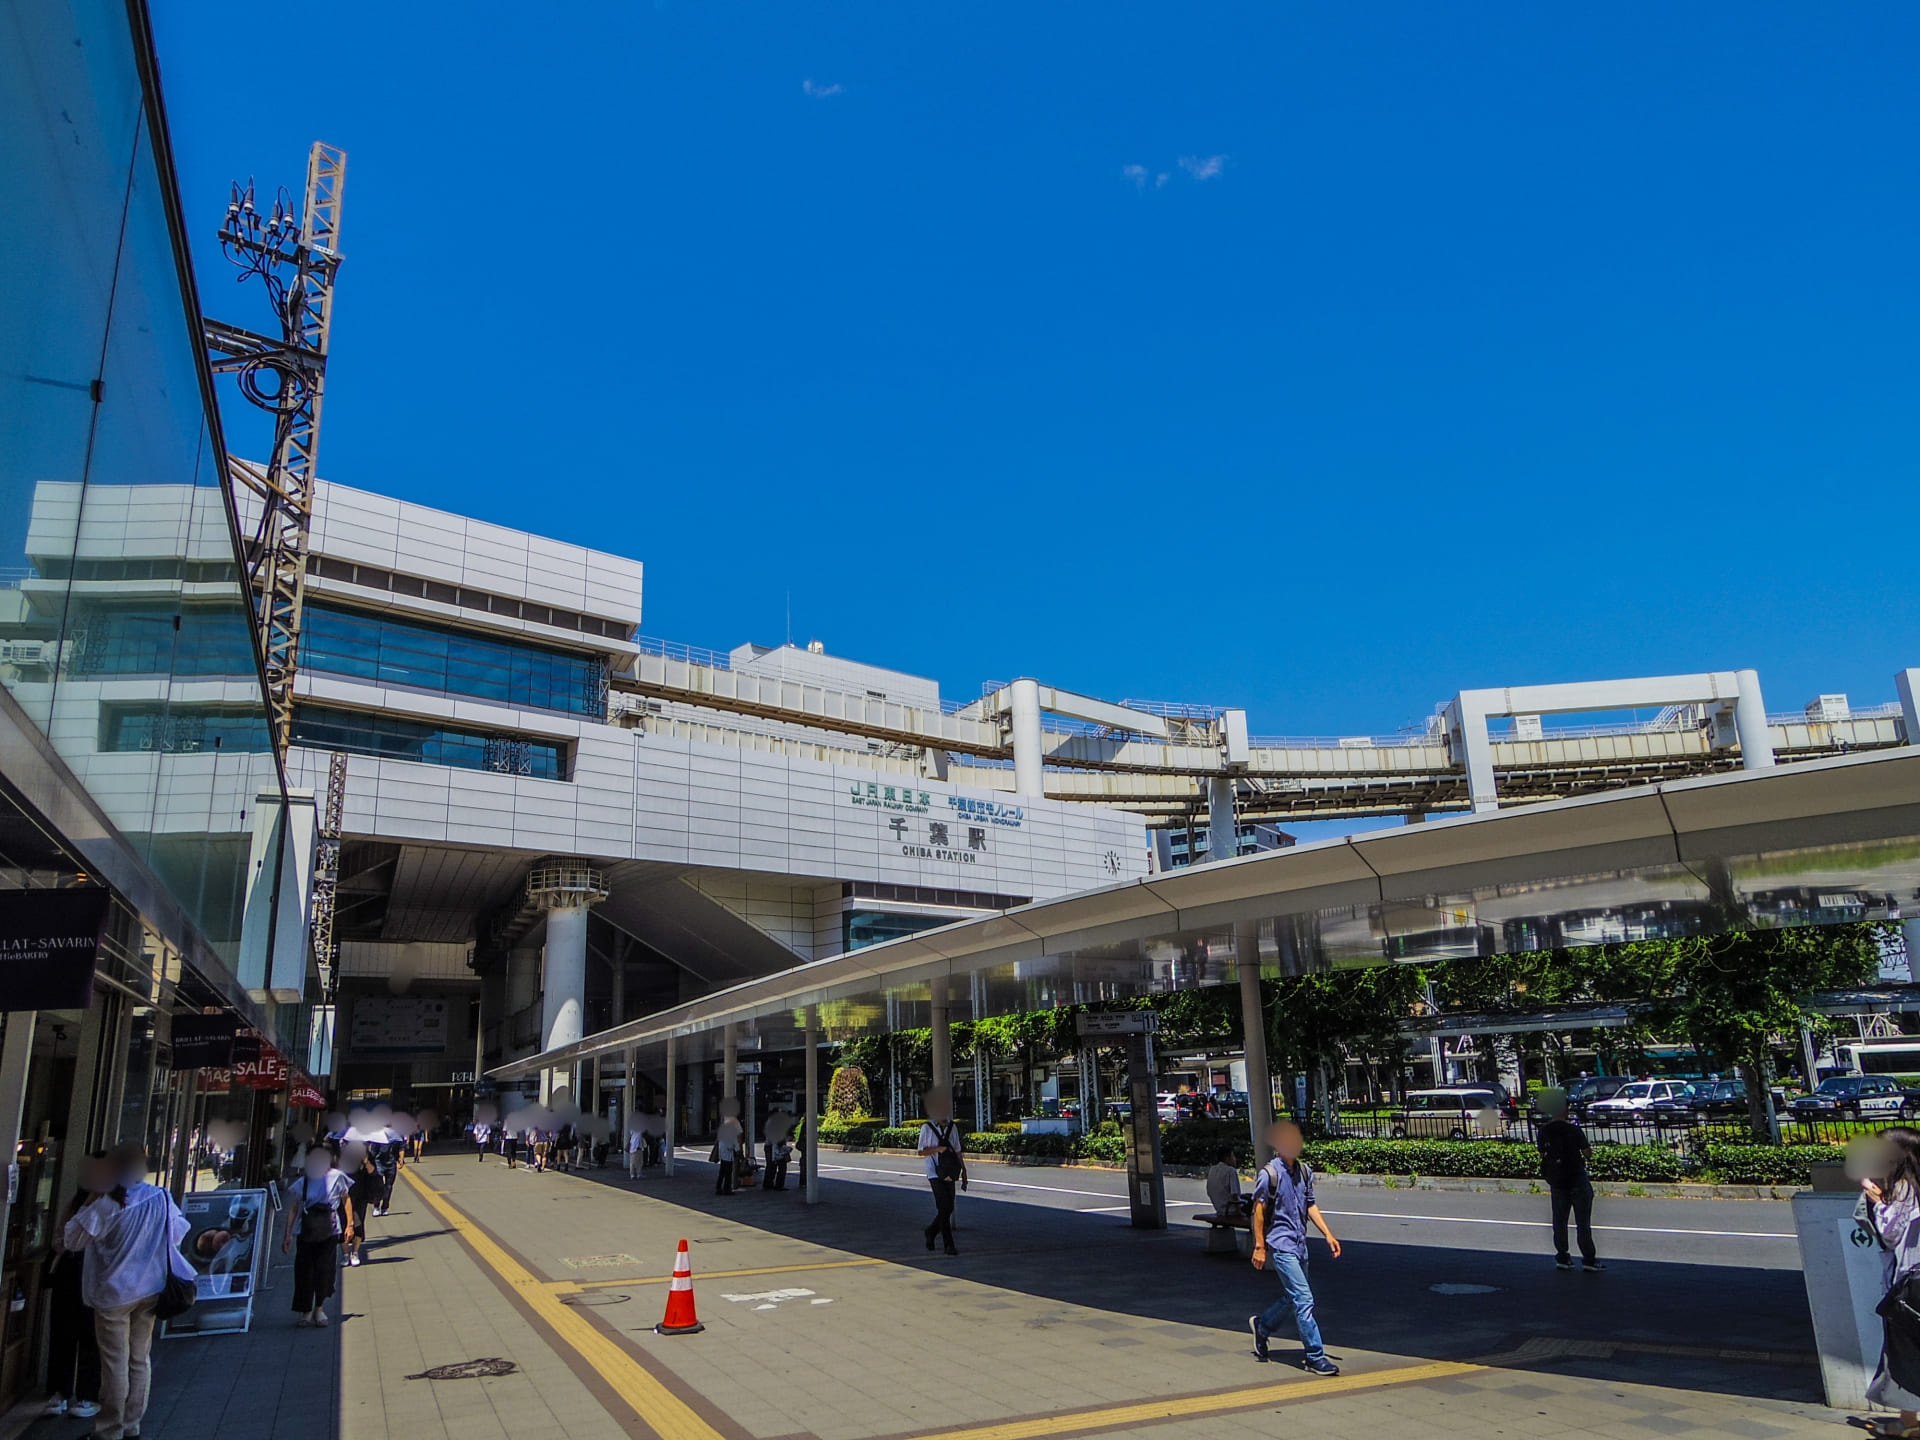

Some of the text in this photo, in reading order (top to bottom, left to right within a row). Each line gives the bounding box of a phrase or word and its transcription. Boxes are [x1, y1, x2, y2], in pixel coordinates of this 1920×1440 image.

[850, 780, 930, 806] JR東日本
[852, 796, 866, 806] EAST
[905, 804, 929, 815] COMPANY
[948, 796, 1024, 820] 千葉都市モノレール
[888, 817, 987, 851] 千葉駅
[902, 845, 976, 864] CHIBA STATION
[1144, 1013, 1156, 1029] 11
[236, 1059, 277, 1076] SALE
